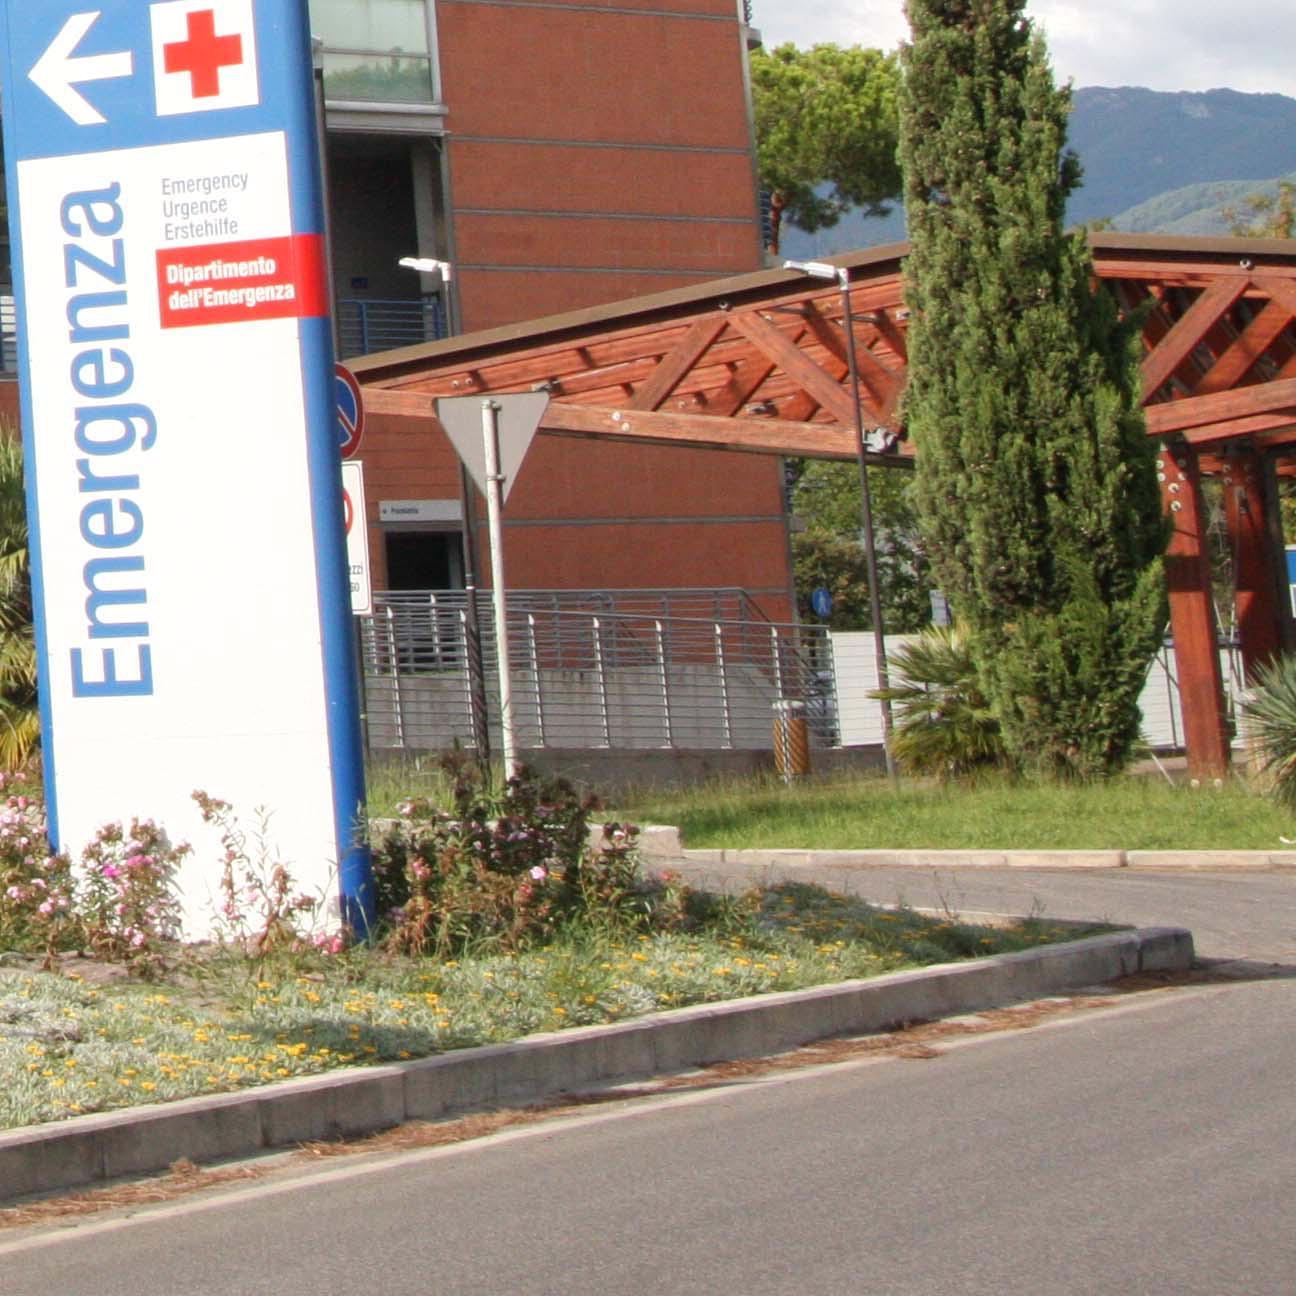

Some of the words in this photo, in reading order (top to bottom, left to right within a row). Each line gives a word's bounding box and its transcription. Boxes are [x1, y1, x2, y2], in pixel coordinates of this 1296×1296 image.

[161, 172, 248, 195] Emergency
[163, 197, 228, 220] Urgence
[165, 217, 239, 241] Erstehilfe
[166, 256, 276, 286] Dipartimento
[169, 283, 295, 310] dell'Emergenza
[60, 181, 157, 699] Emergenza
